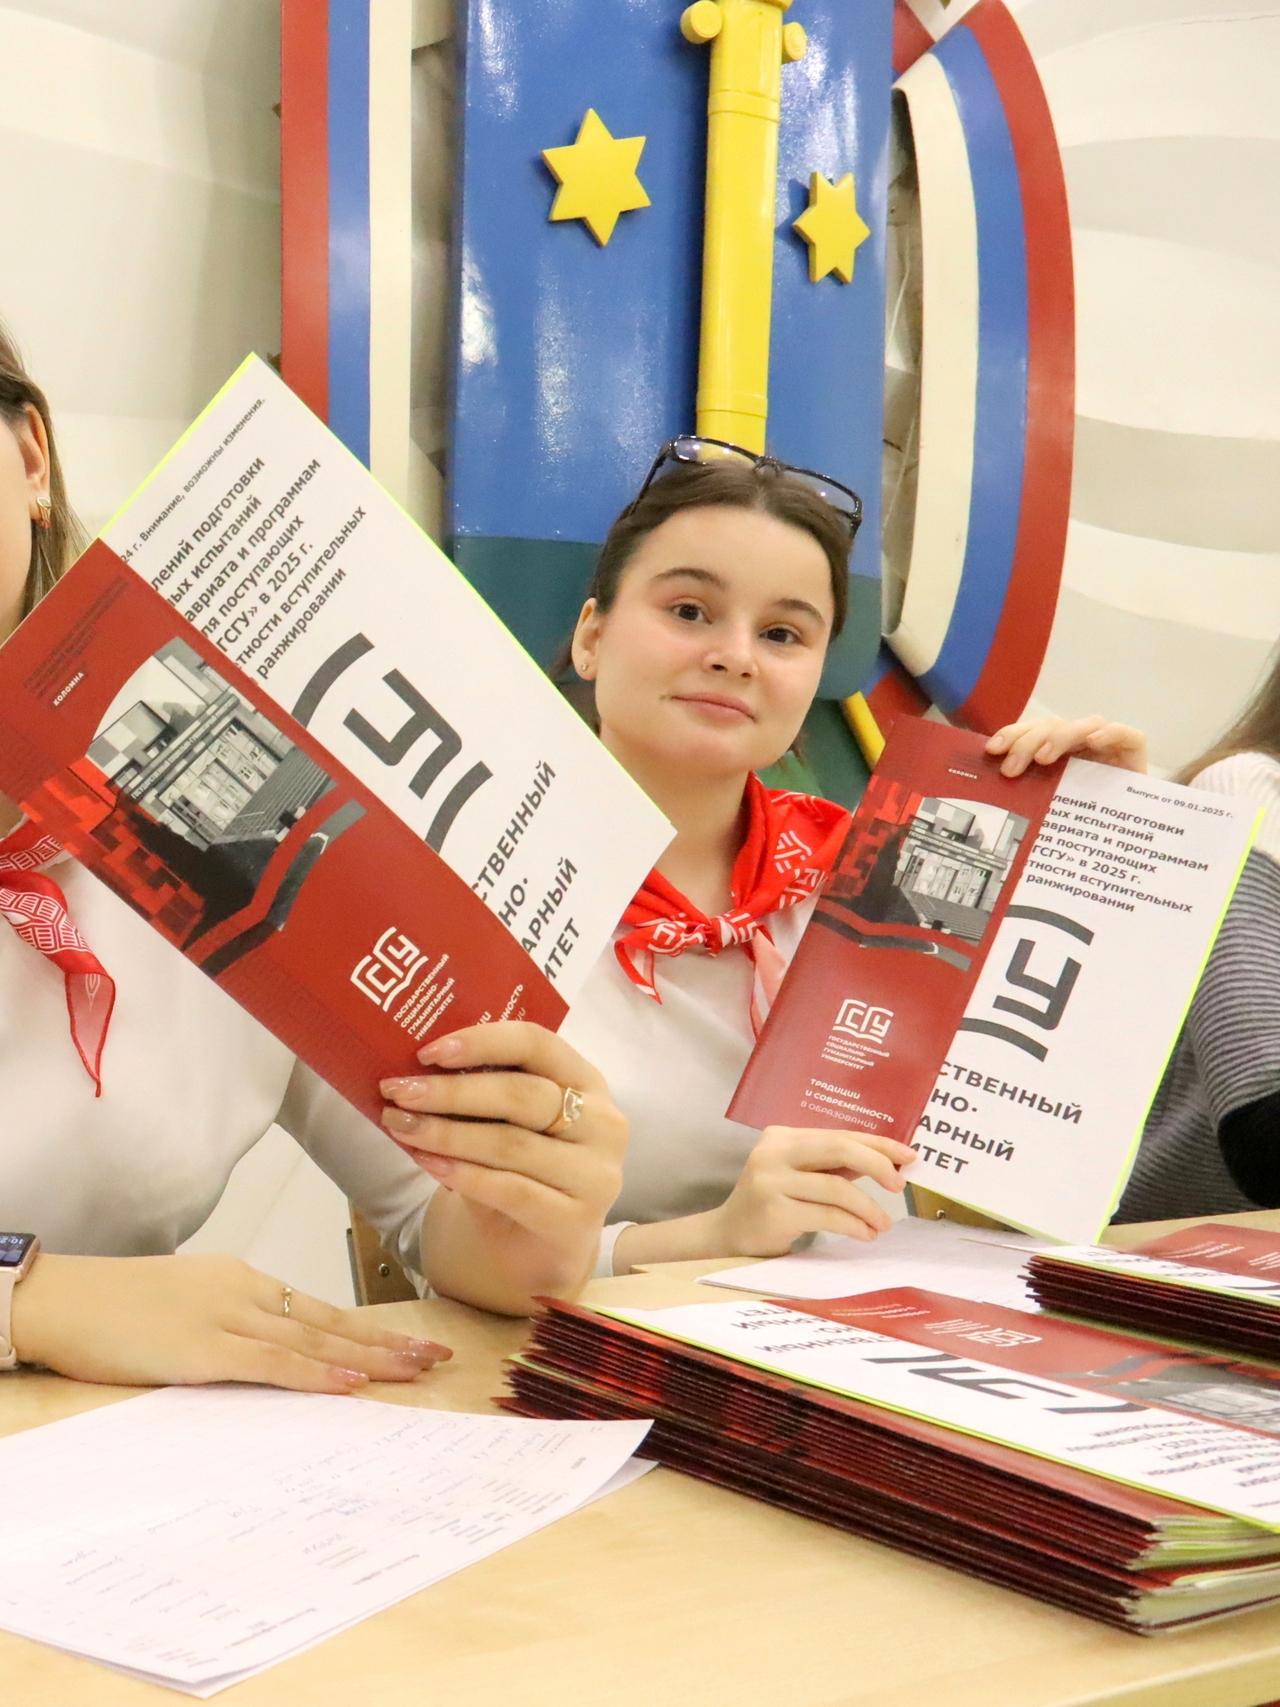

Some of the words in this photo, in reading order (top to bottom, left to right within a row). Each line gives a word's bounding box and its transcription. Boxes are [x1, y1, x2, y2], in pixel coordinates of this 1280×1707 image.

[139, 495, 184, 541] Внимание,
[183, 445, 224, 493] возможны
[192, 458, 264, 542] подготовки
[237, 547, 249, 560] и
[248, 459, 320, 547] программам
[191, 497, 261, 579] испытаний
[218, 516, 304, 617] поступающих
[259, 593, 270, 604] в
[267, 556, 301, 592] 2025
[299, 543, 313, 555] г.
[280, 506, 366, 614] вступительных
[256, 569, 346, 680] ранжировании
[53, 672, 84, 706] КОЛОМНА
[1126, 786, 1159, 800] Выпуск
[1174, 799, 1224, 816] 09.01.2025
[1074, 814, 1154, 842] испытаний
[1100, 806, 1184, 835] подготовки
[1057, 839, 1157, 873] поступающих
[1079, 859, 1087, 867] в
[1092, 861, 1127, 879] 2025
[1130, 875, 1140, 884] г.
[1103, 837, 1112, 845] и
[1116, 841, 1208, 871] программам
[1026, 874, 1134, 912] ранжировании
[1080, 875, 1192, 912] вступительных
[393, 954, 449, 1021] ГОСУДАРСТВЕННЫЙ
[401, 984, 438, 1028] СОЦИАЛЬНО-
[811, 1078, 860, 1099] ТРАДИЦИИ
[808, 1103, 877, 1129] ОБРАЗОВАНИИ
[813, 1093, 894, 1122] СОВРЕМЕННОСТЬ
